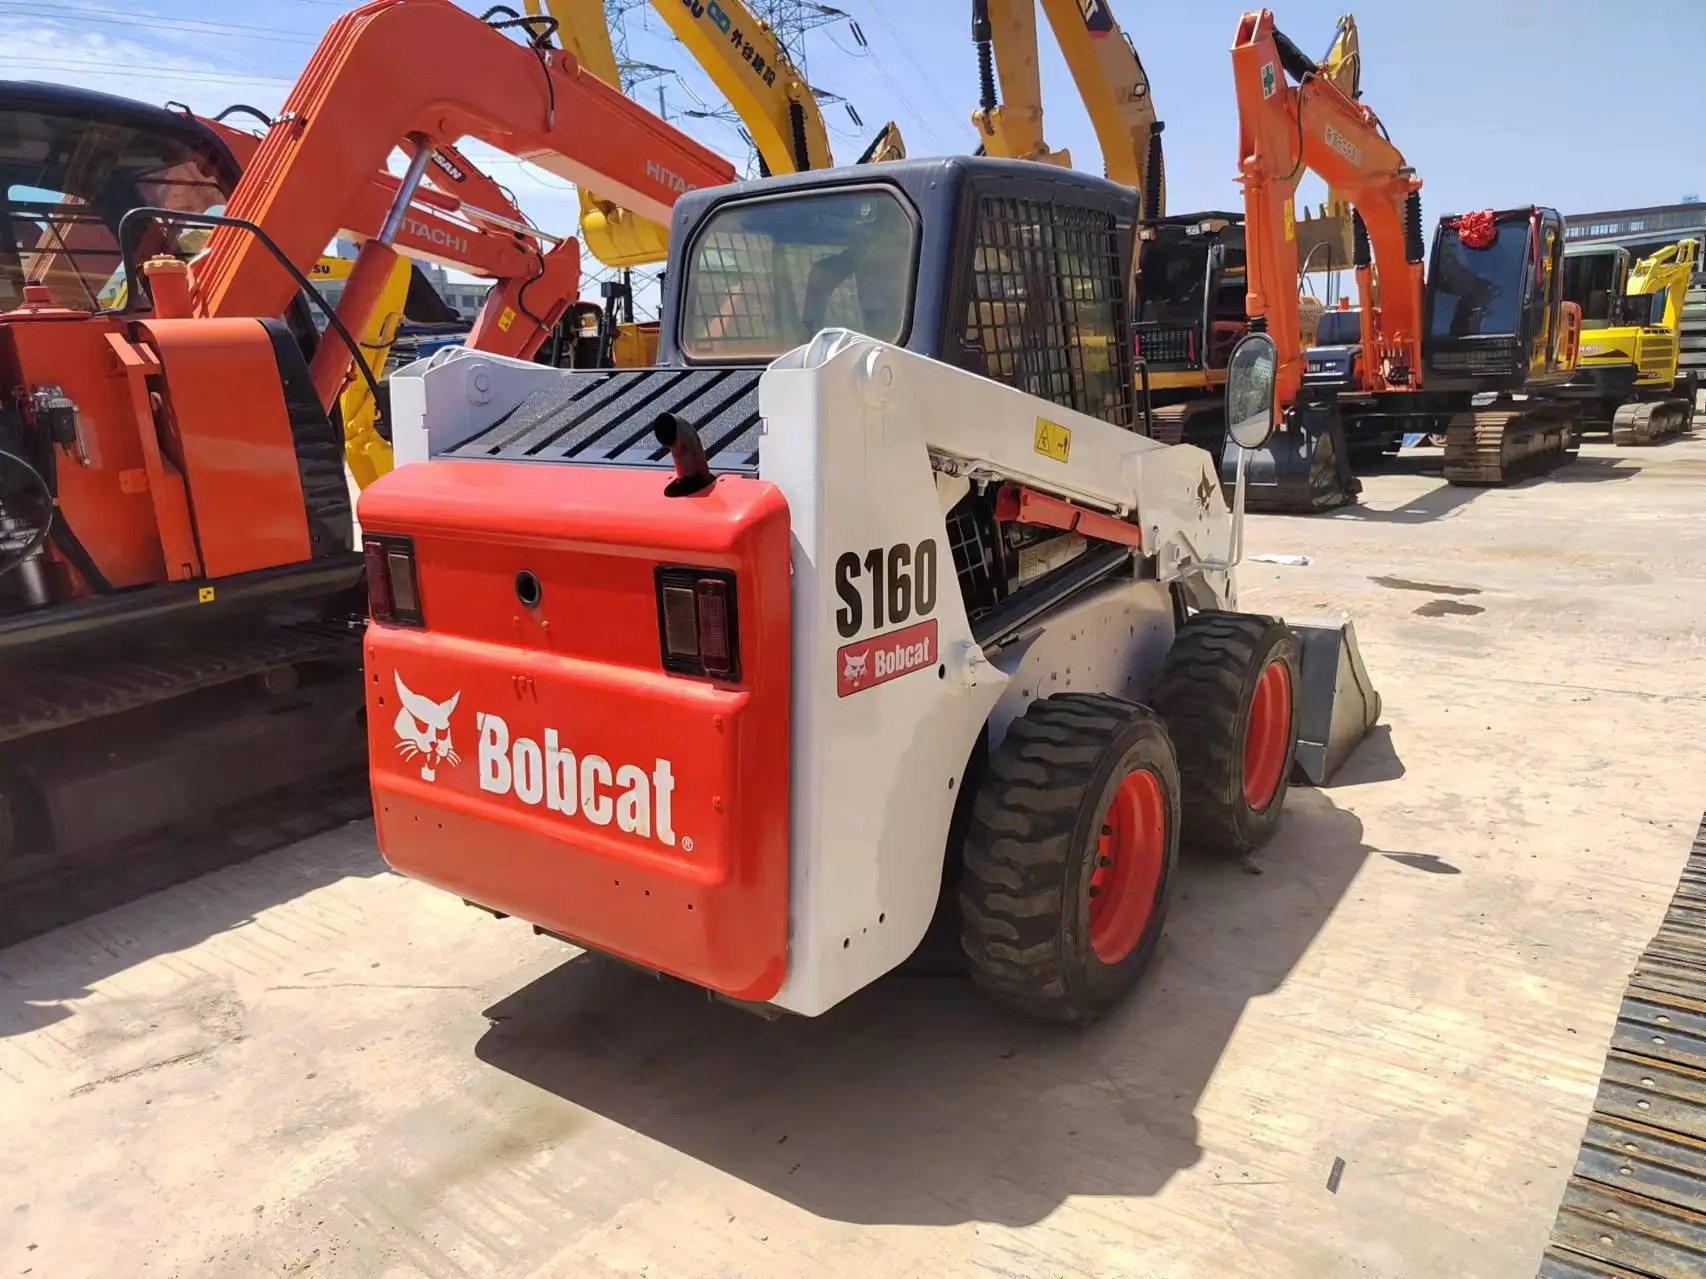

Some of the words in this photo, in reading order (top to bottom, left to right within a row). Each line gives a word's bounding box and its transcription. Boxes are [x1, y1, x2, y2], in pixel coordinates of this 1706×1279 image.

[400, 216, 468, 253] ITACHI
[835, 538, 937, 639] S160
[875, 636, 930, 678] Bobcat
[476, 711, 676, 847] Bobcat
